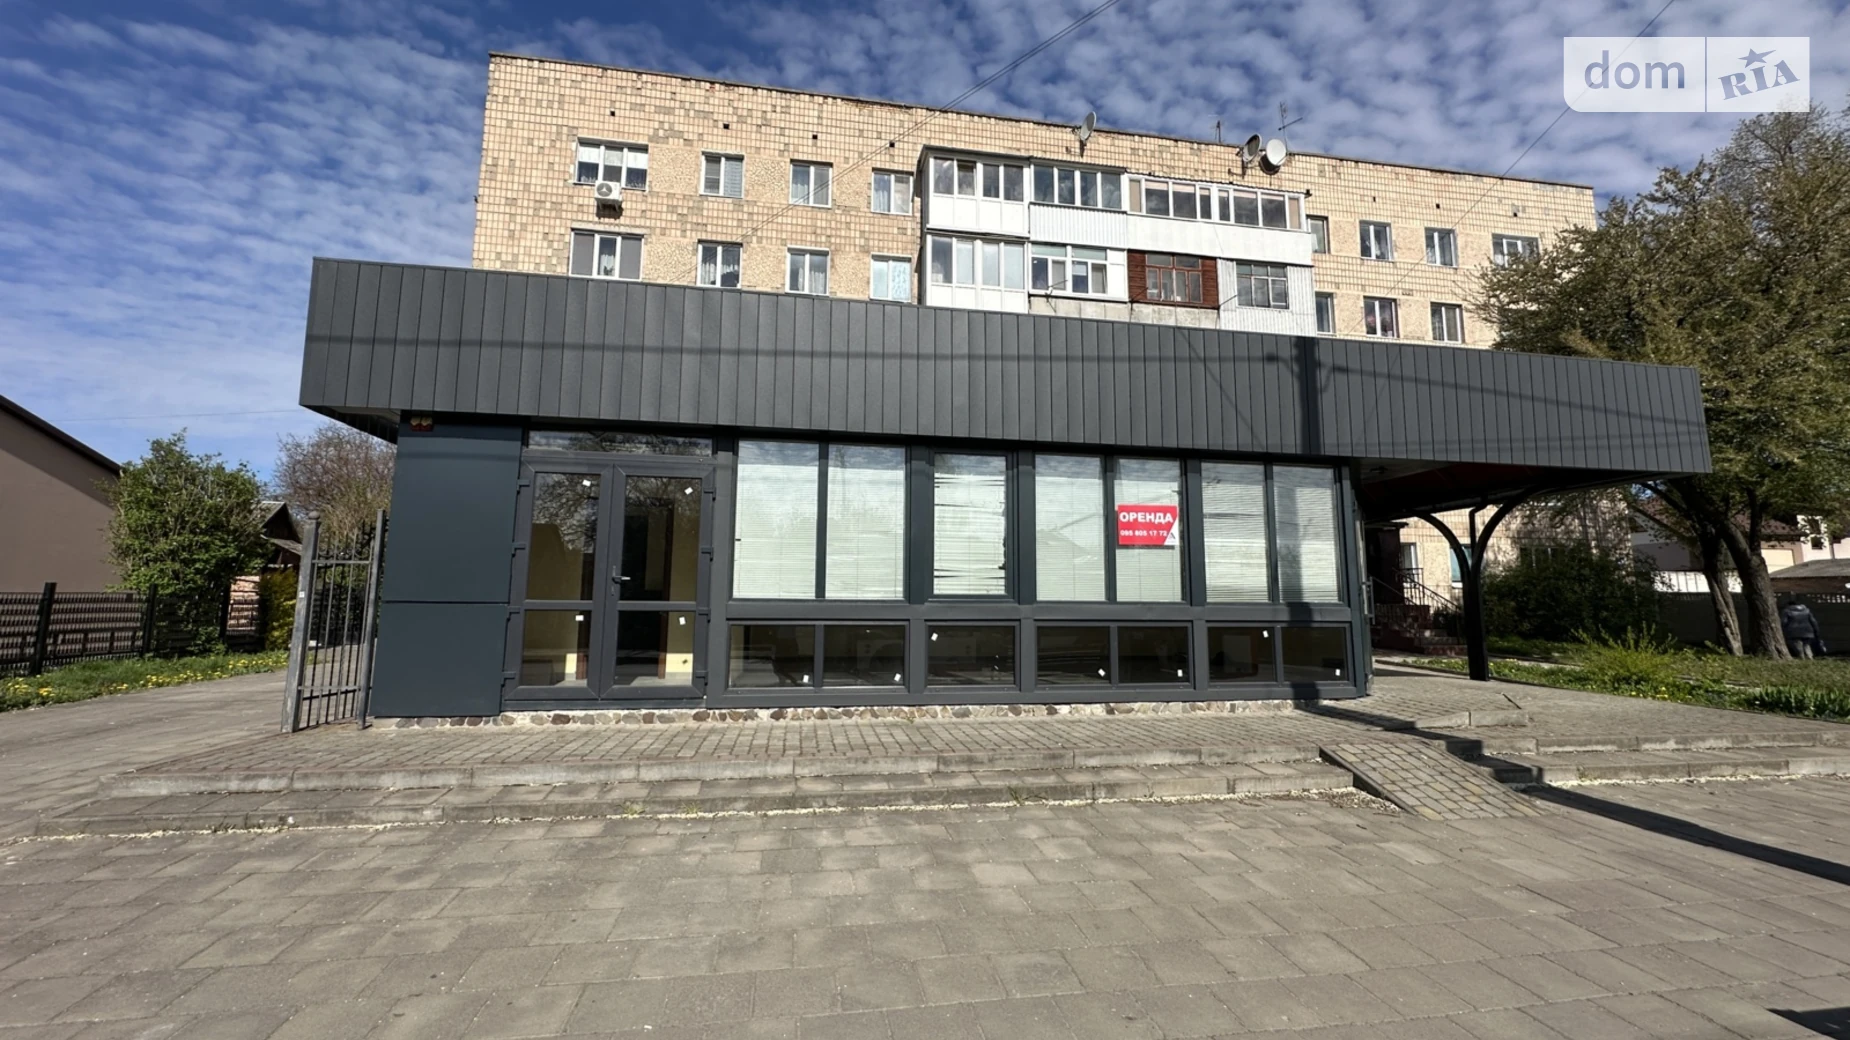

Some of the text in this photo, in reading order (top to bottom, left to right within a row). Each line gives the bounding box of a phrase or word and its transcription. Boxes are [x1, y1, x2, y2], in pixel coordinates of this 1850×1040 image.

[1119, 512, 1173, 524] ОРЕНДА
[1149, 529, 1157, 537] 17
[1159, 529, 1168, 537] 72
